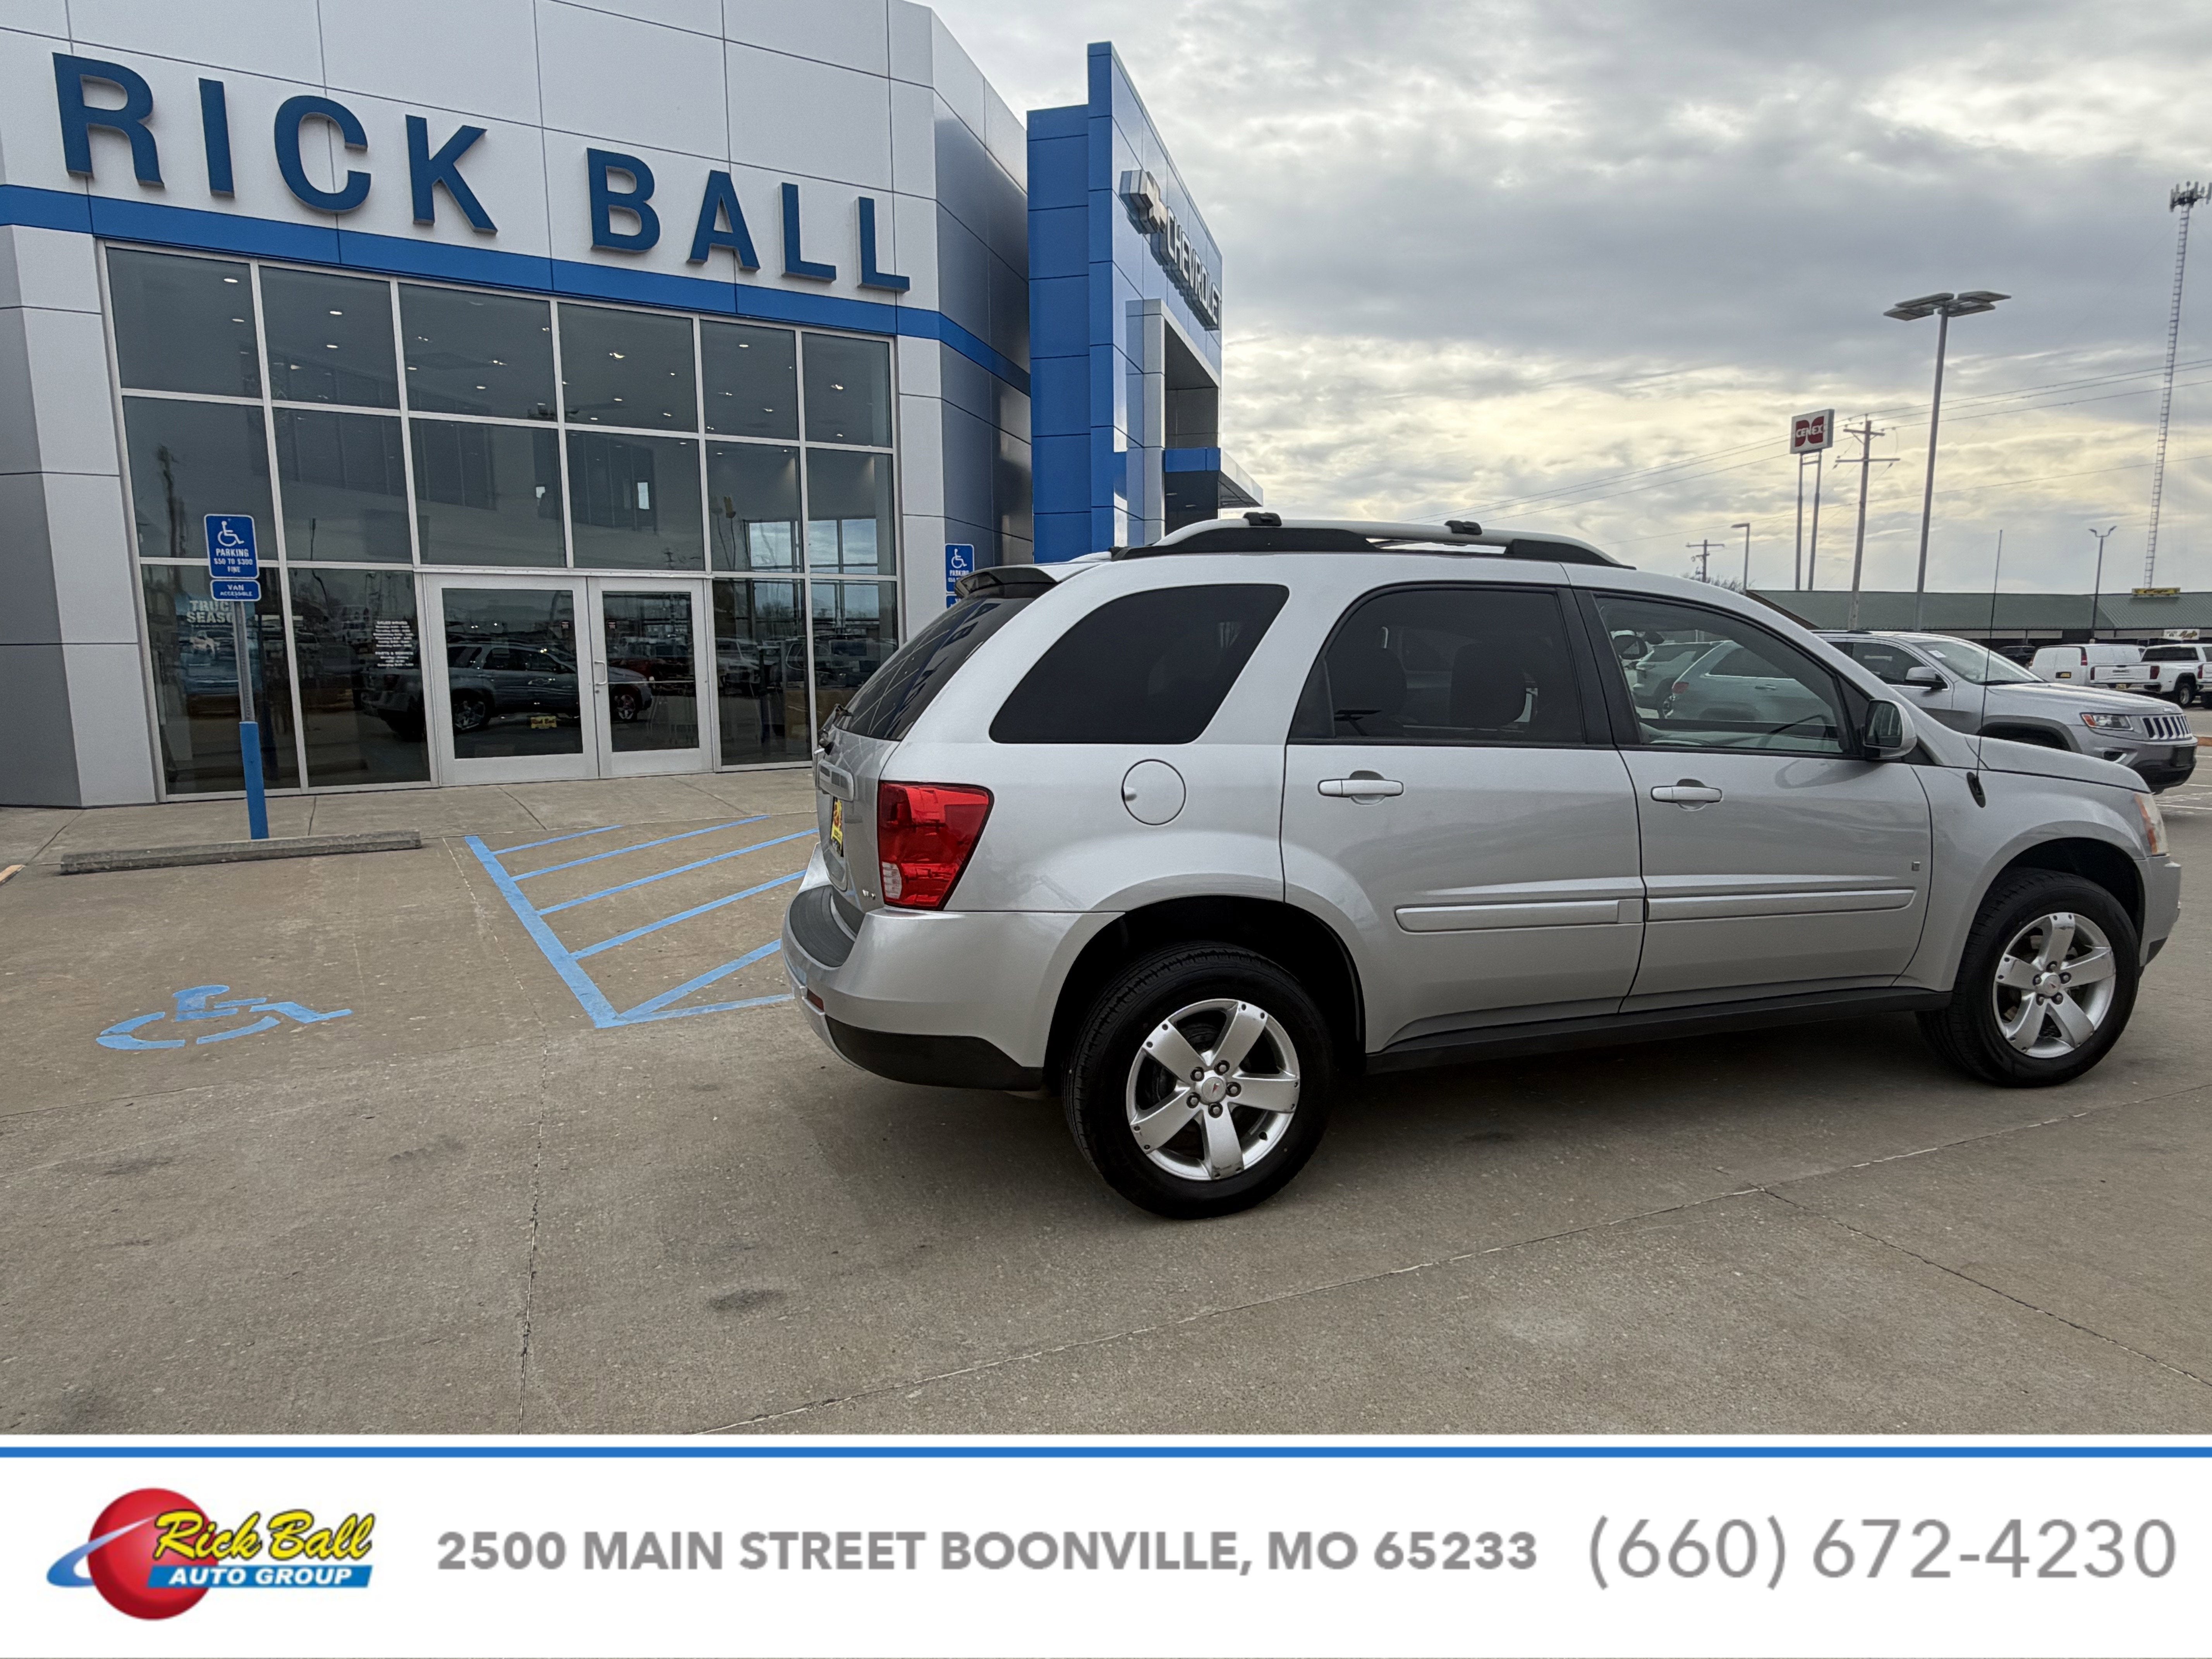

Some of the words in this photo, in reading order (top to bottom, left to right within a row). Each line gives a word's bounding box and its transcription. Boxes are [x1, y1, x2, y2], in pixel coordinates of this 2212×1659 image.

[52, 52, 498, 234] RICK
[586, 147, 910, 293] BALL
[1795, 424, 1825, 438] CENEX
[215, 548, 249, 557] PARKING
[190, 600, 232, 611] TRUC
[186, 611, 233, 623] SEASO
